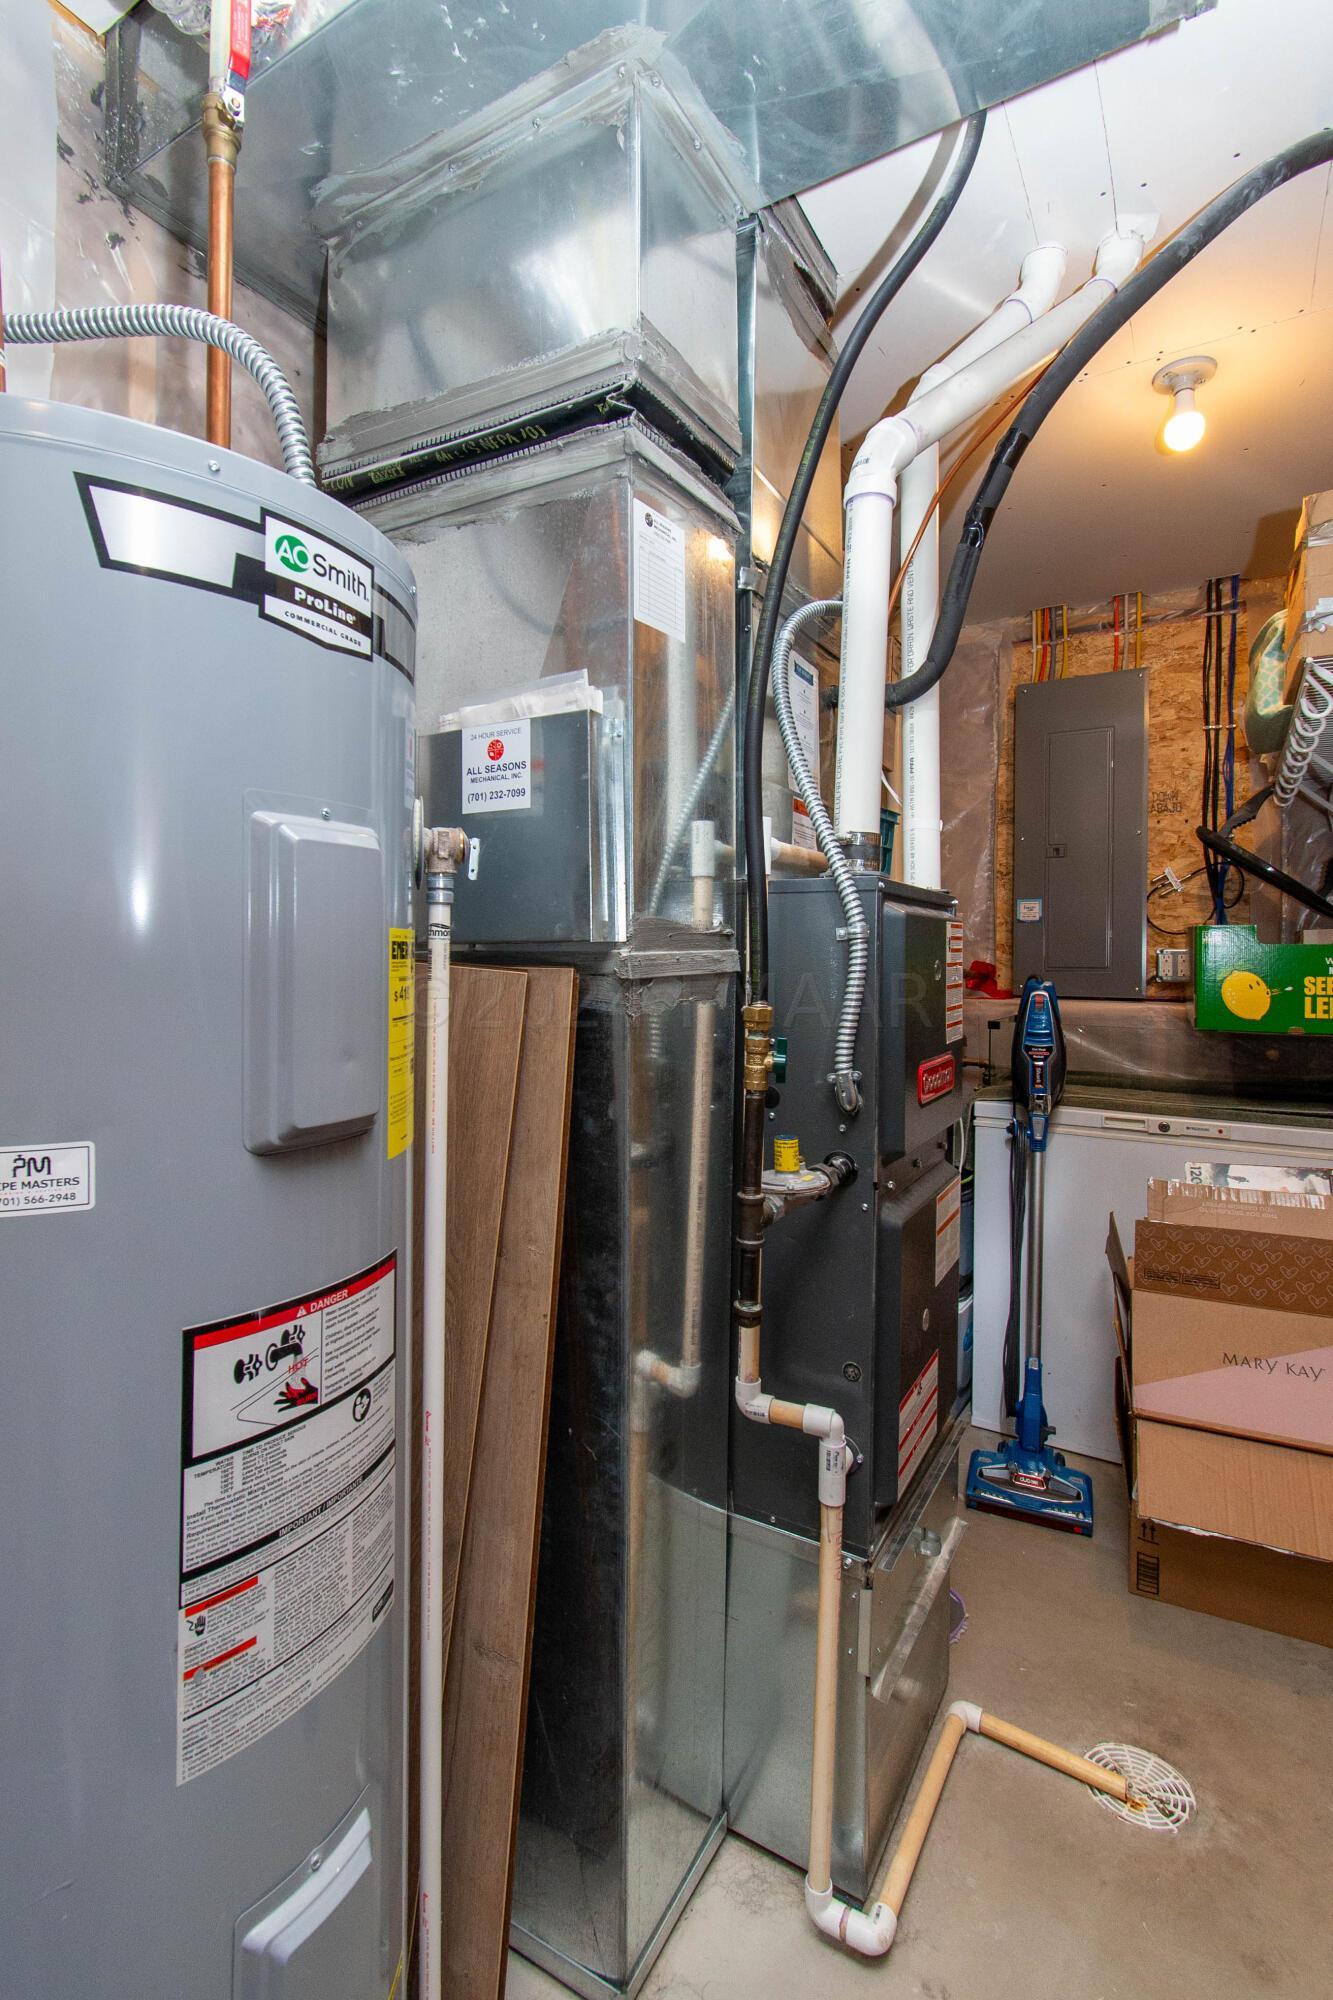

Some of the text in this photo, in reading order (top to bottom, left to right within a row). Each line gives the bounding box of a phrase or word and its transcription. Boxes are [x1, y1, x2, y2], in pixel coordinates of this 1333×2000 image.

[277, 540, 367, 601] AO Smith
[906, 570, 914, 589] VENT
[294, 586, 354, 625] ProLine
[906, 590, 914, 604] AND
[285, 610, 362, 647] COMMERCIAL GRADE
[906, 608, 914, 630] WASTE
[906, 632, 914, 657] DRAIN
[906, 658, 914, 673] FOR
[478, 731, 495, 740] HOUR
[496, 727, 521, 737] SERVICE
[466, 760, 527, 776] ALL SEASONS
[467, 787, 526, 804] (701) 232-7099
[922, 1066, 953, 1094] Goodman
[21, 1176, 80, 1190] MASTERS
[24, 1192, 76, 1205] 566-2948
[310, 1289, 348, 1312] DANGER
[1222, 1351, 1323, 1382] MARY KAY
[195, 1460, 234, 1479] TEMPERATURE
[208, 1493, 245, 1513] Thermostatic
[280, 1507, 321, 1537] IMPORTANT
